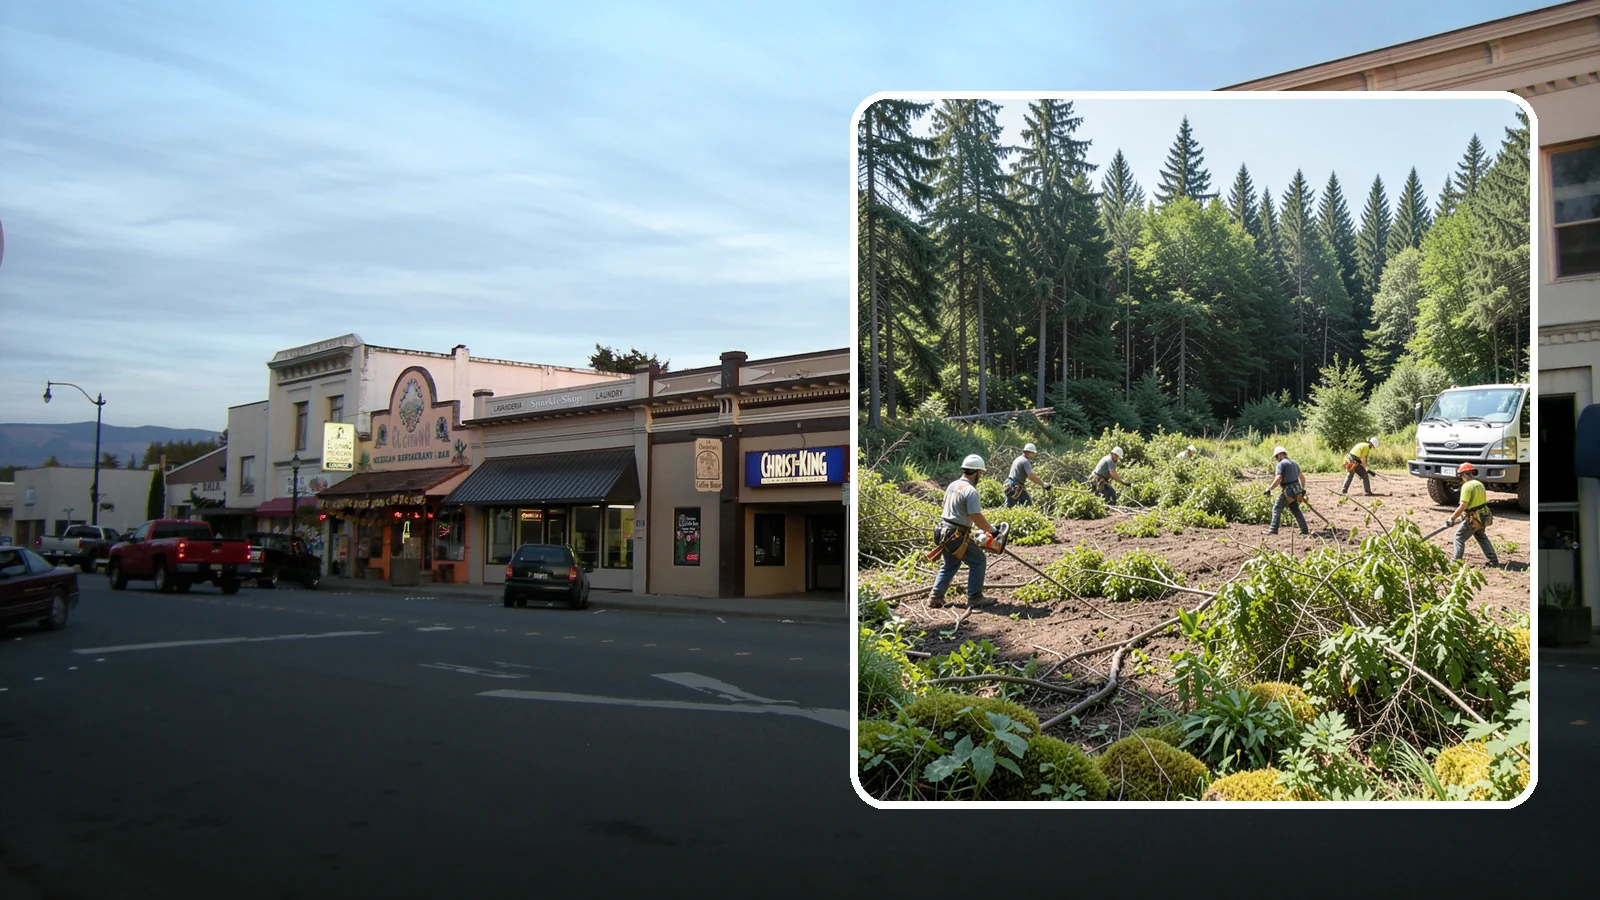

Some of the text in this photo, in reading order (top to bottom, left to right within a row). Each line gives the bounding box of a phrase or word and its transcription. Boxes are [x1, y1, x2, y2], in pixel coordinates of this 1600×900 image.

[596, 389, 623, 400] LAUNDRY
[493, 402, 522, 412] LAVANDERIA
[530, 394, 583, 409] Sparkle Shop
[397, 451, 434, 462] RESTAURANT
[438, 450, 450, 459] BAR
[761, 450, 827, 477] CHRIST KING
